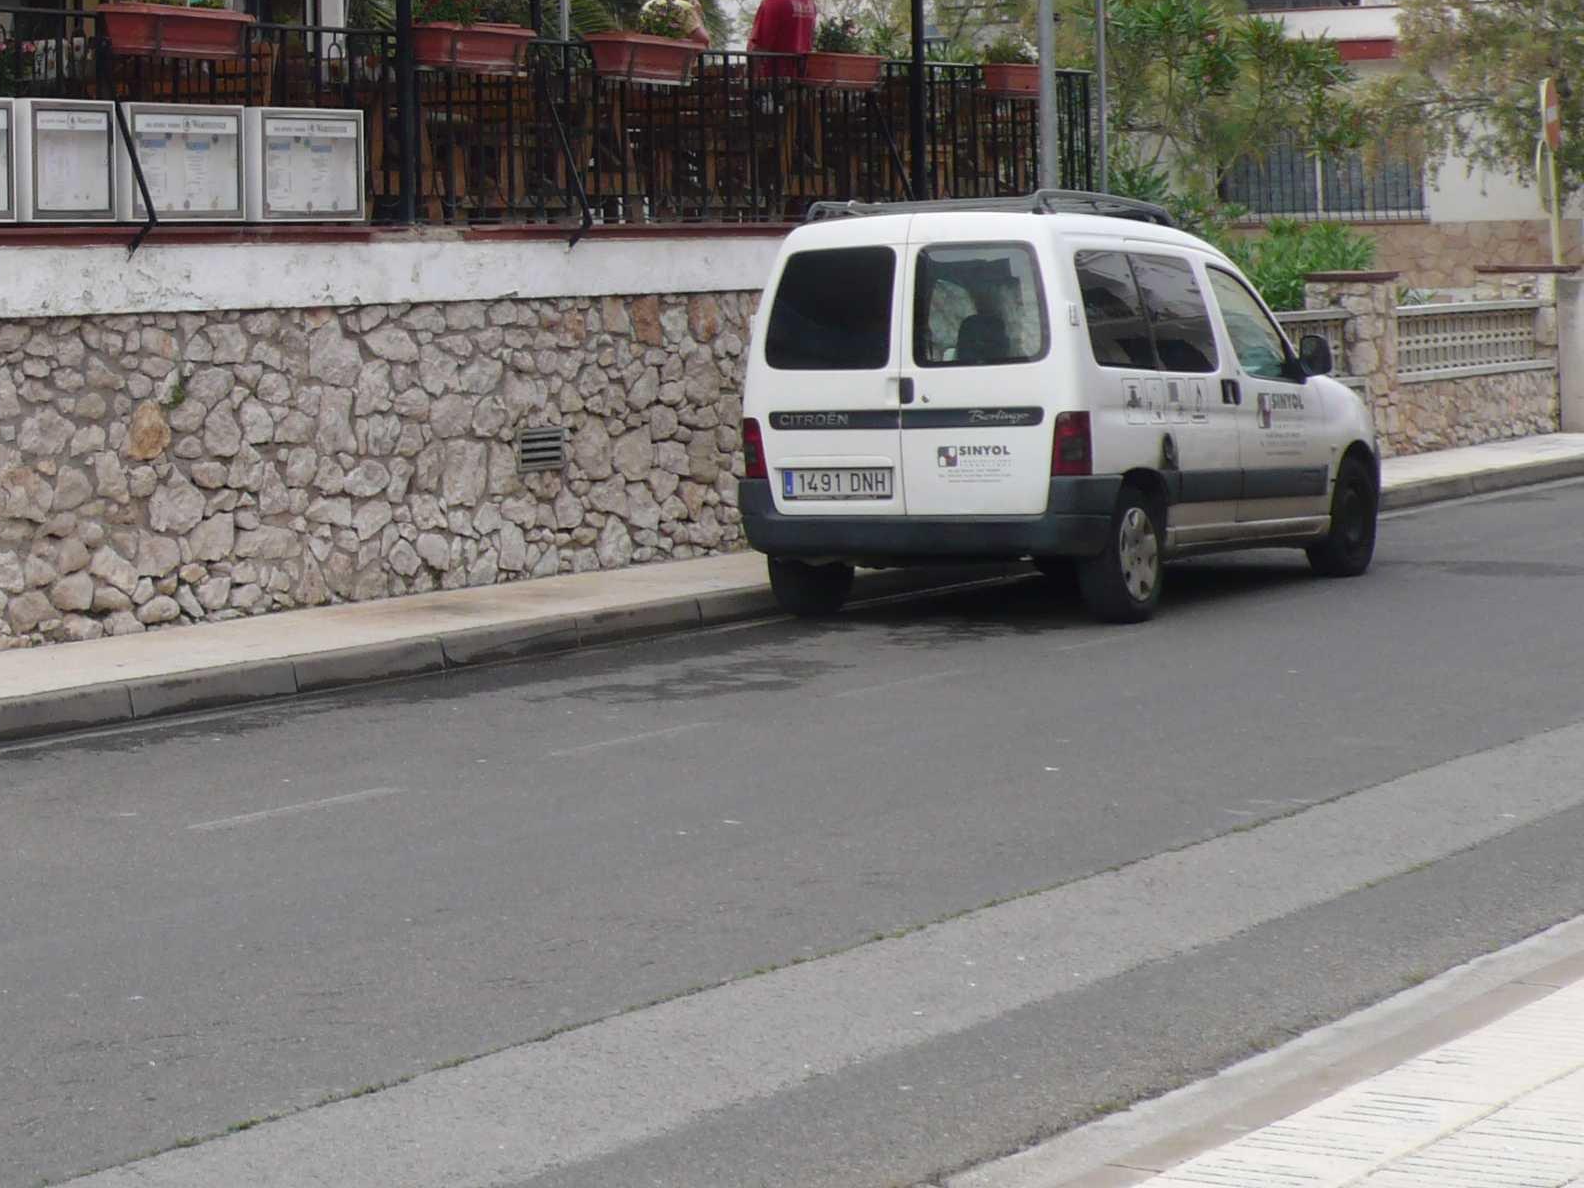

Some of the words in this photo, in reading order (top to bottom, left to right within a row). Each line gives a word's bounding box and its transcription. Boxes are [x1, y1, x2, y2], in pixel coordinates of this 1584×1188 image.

[780, 413, 848, 426] CITROËN
[959, 445, 1011, 456] SINYOL
[800, 473, 841, 492] 1491
[851, 473, 886, 492] DNH
